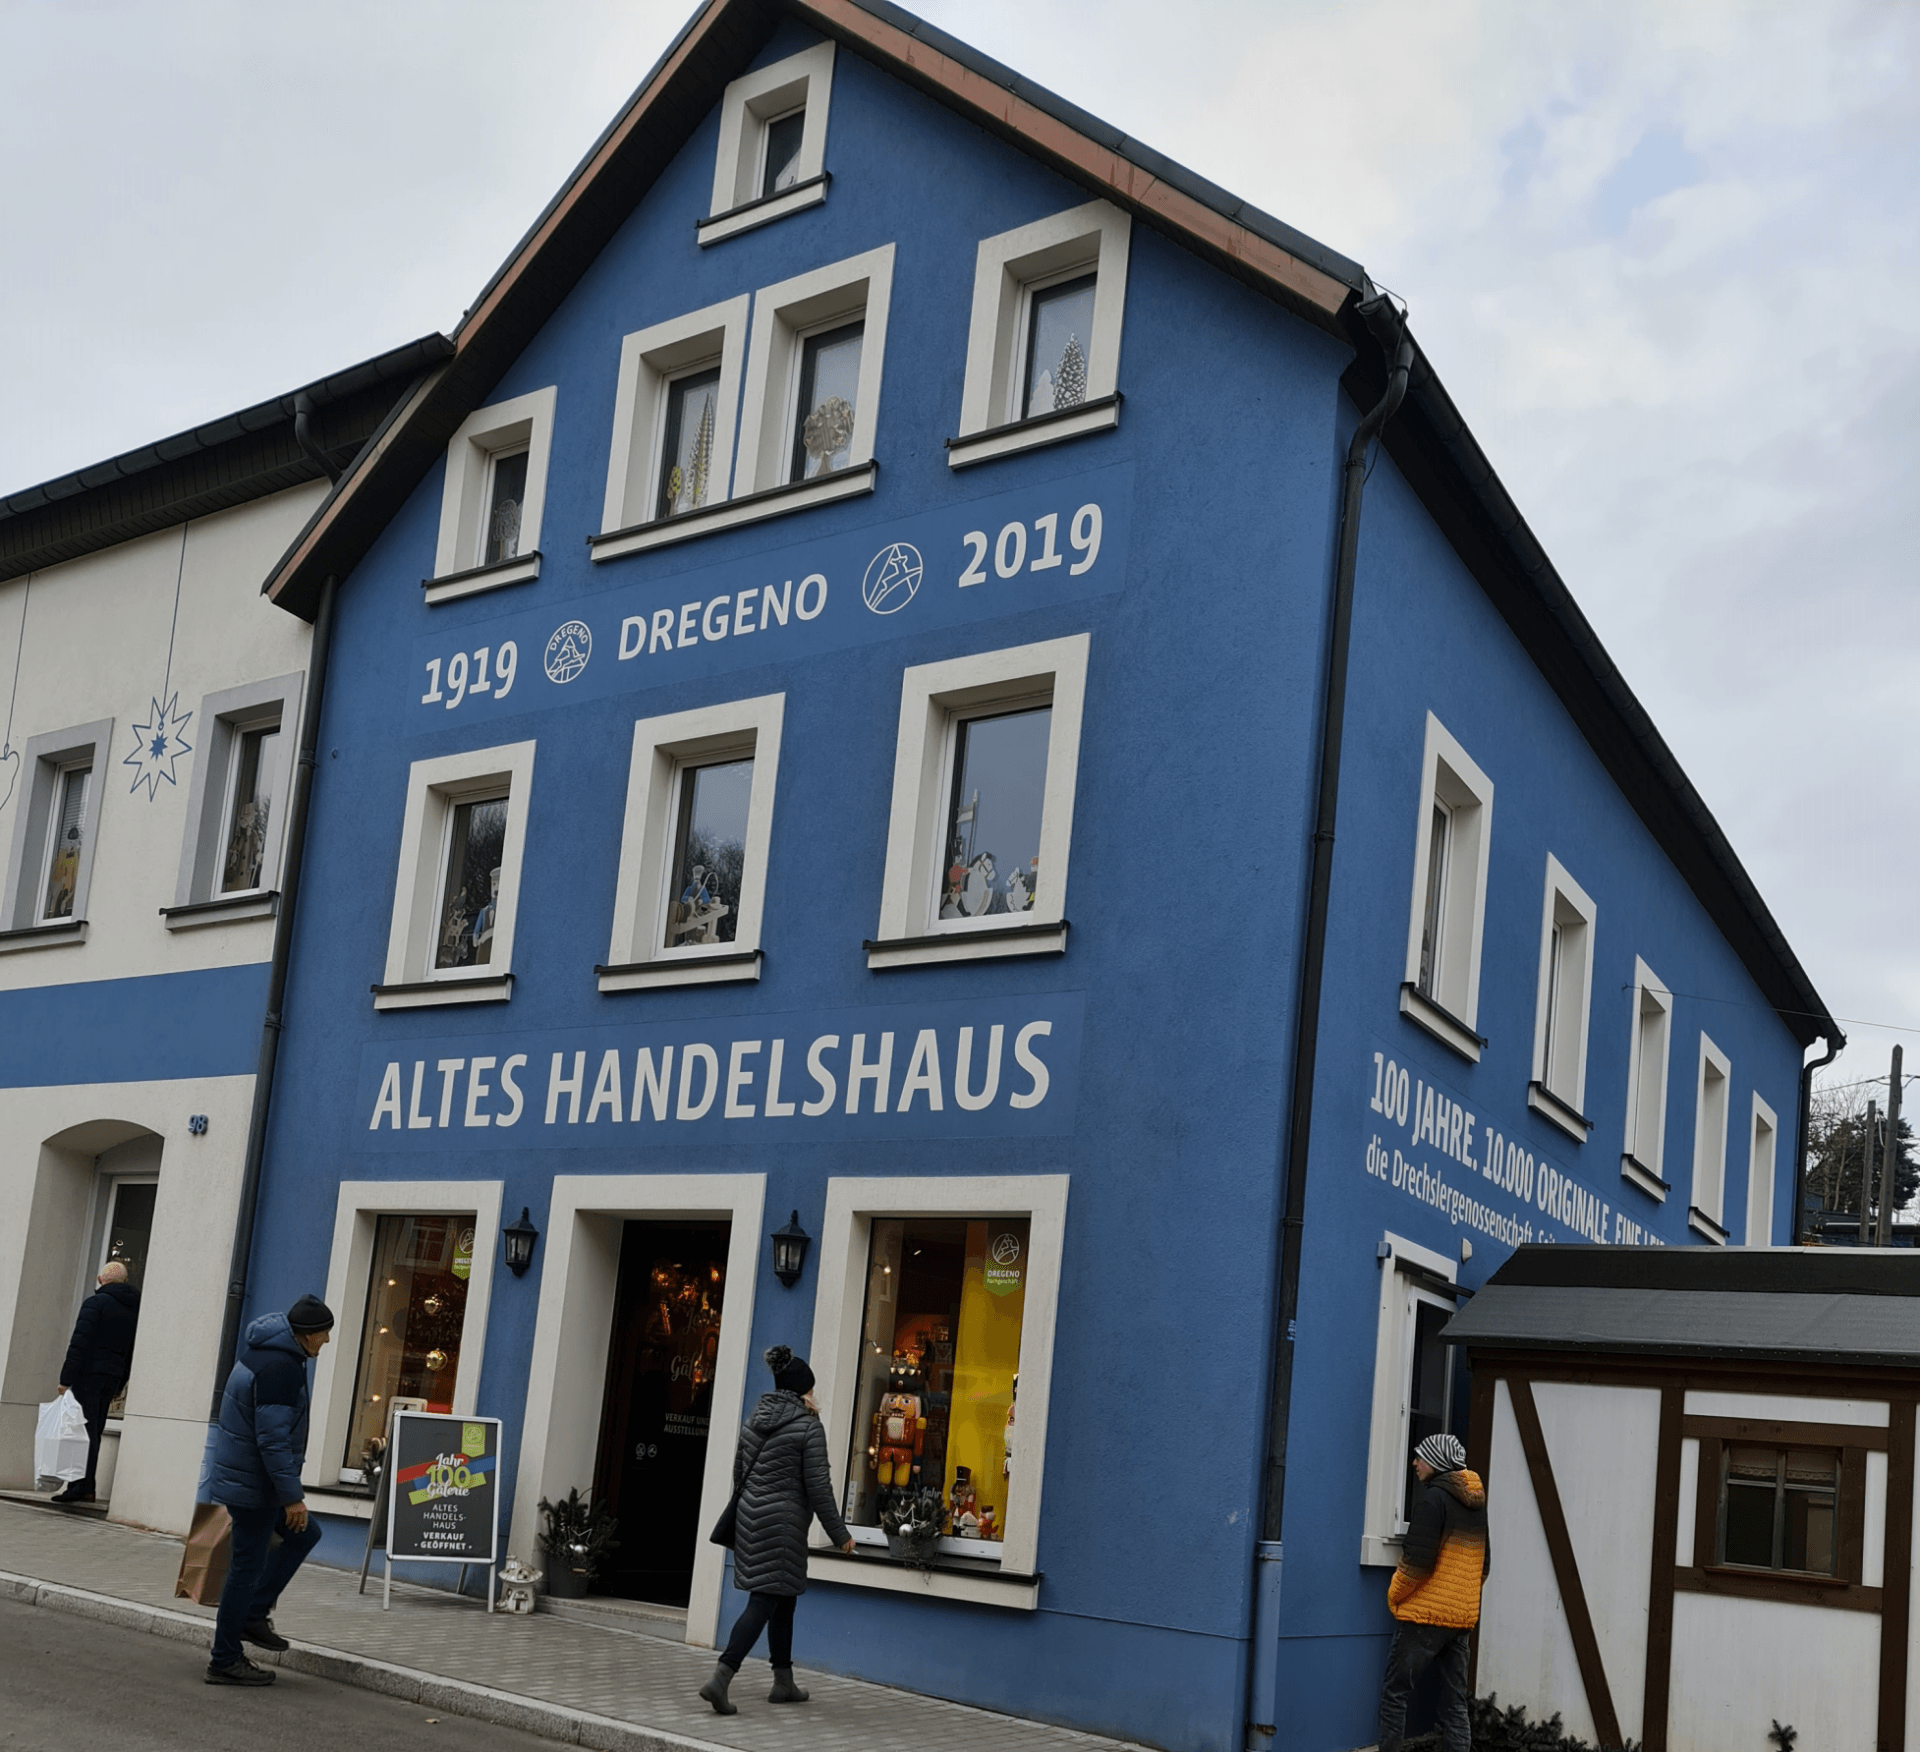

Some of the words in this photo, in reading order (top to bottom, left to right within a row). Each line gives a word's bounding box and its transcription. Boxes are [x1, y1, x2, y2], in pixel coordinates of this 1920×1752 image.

[421, 640, 518, 710] 1919
[617, 573, 828, 661] DREGENO
[958, 503, 1103, 588] 2019
[548, 621, 593, 652] DREGENO
[368, 1053, 528, 1130] ALTES
[544, 1020, 1053, 1125] HANDELSHAUS
[188, 1114, 208, 1136] 98
[1370, 1051, 1410, 1127] 100
[1411, 1079, 1478, 1172] JAHRE.
[1482, 1127, 1534, 1203] 10.000
[1366, 1134, 1389, 1181] die
[987, 1269, 1020, 1278] DREGENO
[664, 1412, 696, 1424] VERKAUF
[435, 1452, 465, 1471] Jahr
[425, 1464, 471, 1489] 100
[426, 1478, 471, 1500] Galerie
[423, 1511, 467, 1521] HANDELS-
[432, 1503, 458, 1512] ALTES
[432, 1521, 456, 1530] HAUS
[420, 1540, 467, 1550] GEÖFFNET
[423, 1531, 465, 1541] VERKAUF
